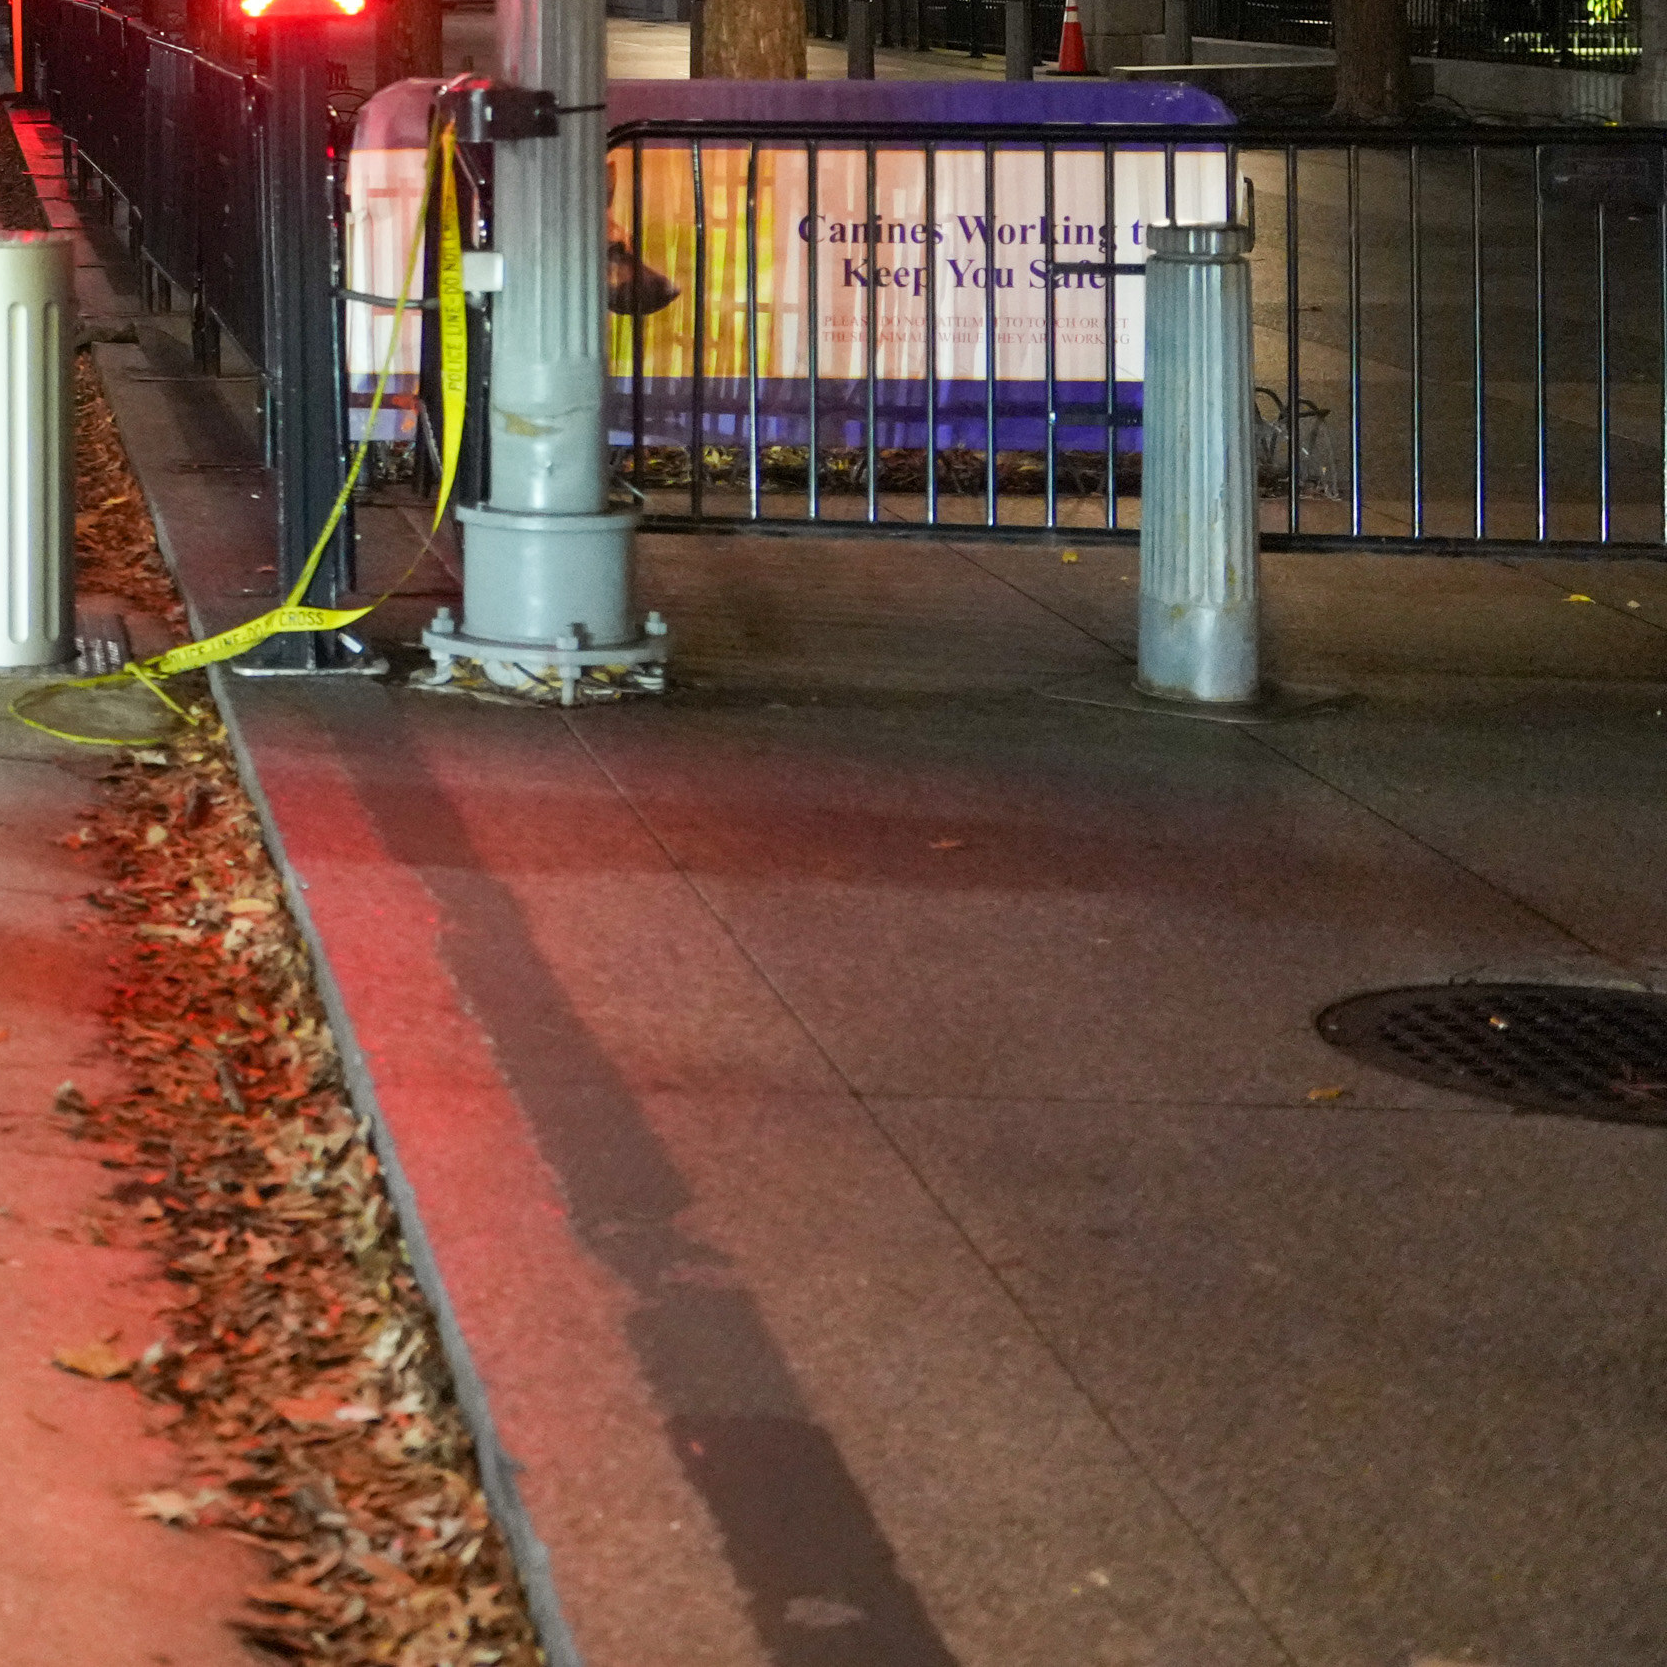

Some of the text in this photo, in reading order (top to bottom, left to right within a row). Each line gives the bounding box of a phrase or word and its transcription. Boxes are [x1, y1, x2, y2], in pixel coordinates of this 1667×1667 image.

[798, 214, 944, 245] Canines
[957, 215, 1117, 253] Working
[842, 258, 930, 297] Keep
[946, 259, 1014, 289] You
[903, 316, 927, 327] NO
[1026, 318, 1076, 329] TOCH
[1079, 318, 1100, 329] OR
[997, 333, 1026, 344] HEY
[1027, 333, 1048, 344] AR
[279, 611, 325, 626] CROSS
